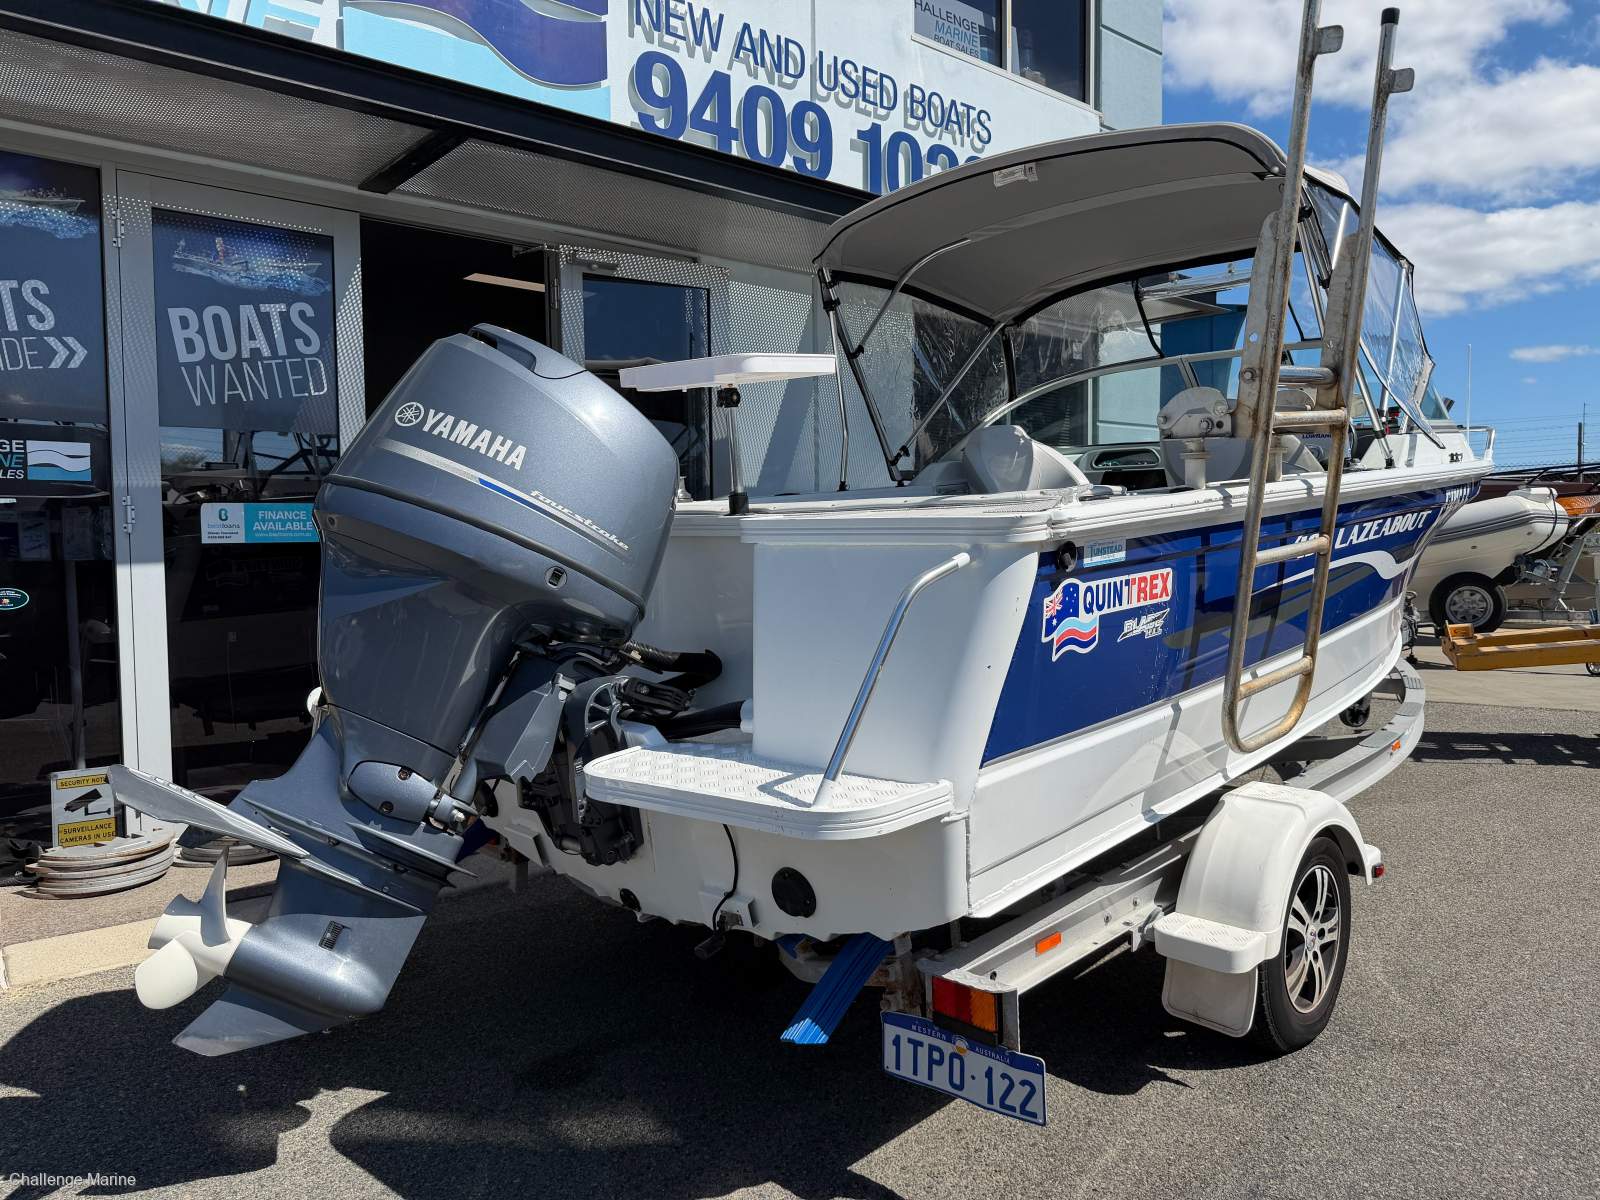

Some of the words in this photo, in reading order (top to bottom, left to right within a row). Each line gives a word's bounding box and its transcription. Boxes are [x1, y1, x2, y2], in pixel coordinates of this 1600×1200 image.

[934, 34, 954, 48] BOAT
[955, 43, 979, 58] SALES
[935, 20, 979, 48] MARINE
[635, 0, 724, 52] NEW
[735, 22, 806, 80] AND
[818, 49, 898, 112] USED
[909, 83, 992, 145] BOATS
[634, 50, 834, 181] 9409
[856, 122, 983, 198] 10
[168, 302, 321, 363] BOATS
[181, 357, 328, 407] WANTED
[422, 408, 527, 471] YAMAHA
[252, 521, 313, 531] AVAILABLE
[258, 510, 307, 520] FINANCE
[1334, 511, 1432, 549] LAZEABOUT
[1083, 572, 1170, 615] QUINTREX
[60, 778, 90, 787] SECURITY
[60, 835, 92, 845] CAMERAS
[102, 830, 117, 838] USE
[63, 822, 112, 835] SURVEILLANCE
[911, 1023, 947, 1042] WESTERN
[975, 1045, 1011, 1065] AUSTRALIA
